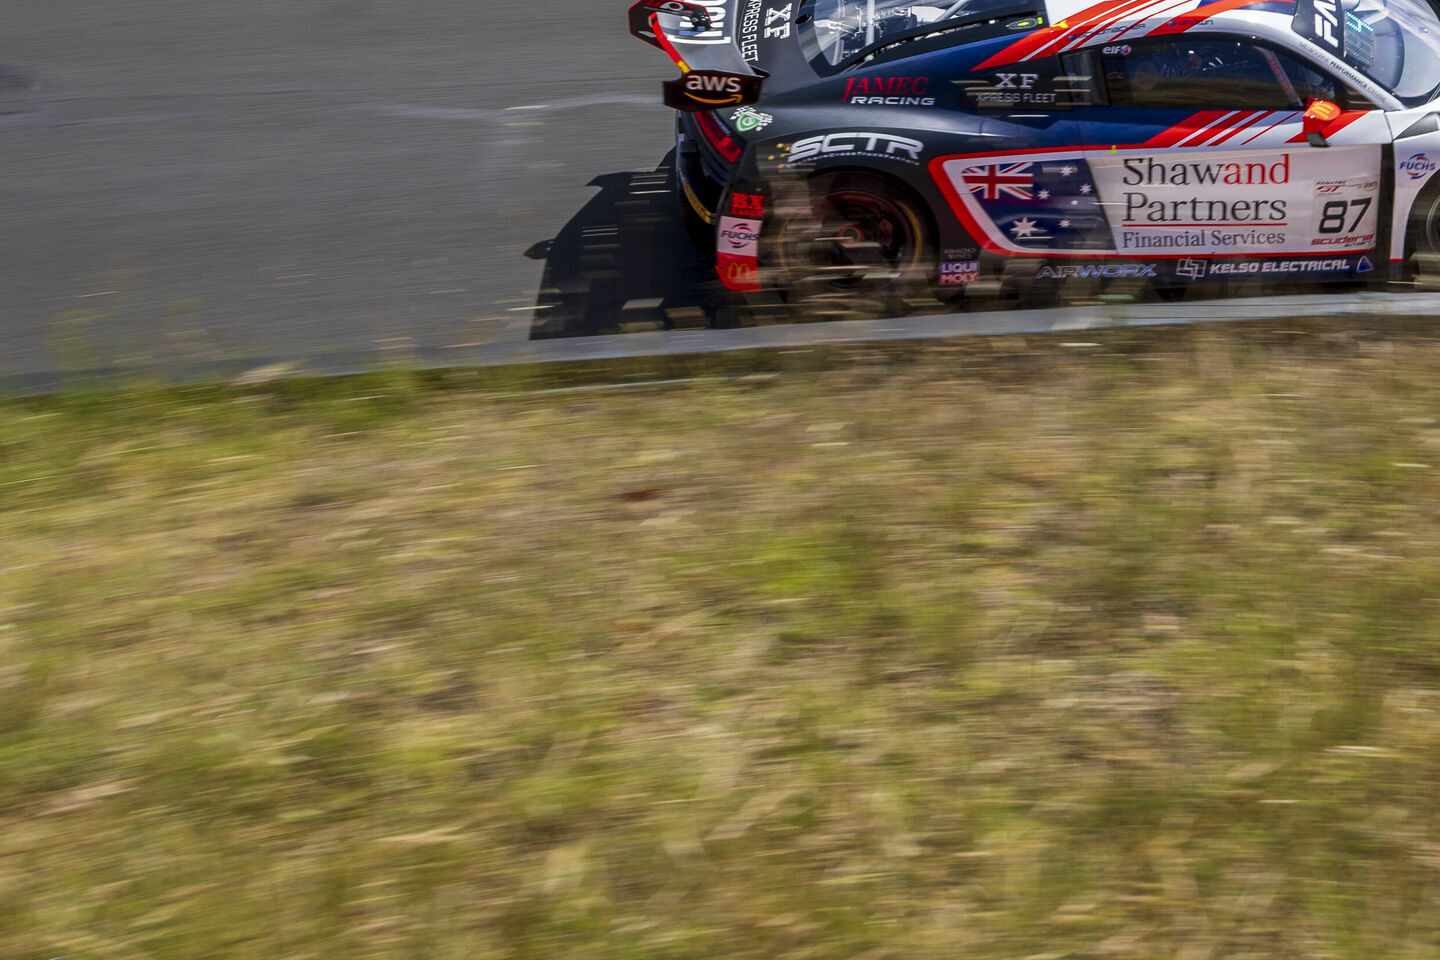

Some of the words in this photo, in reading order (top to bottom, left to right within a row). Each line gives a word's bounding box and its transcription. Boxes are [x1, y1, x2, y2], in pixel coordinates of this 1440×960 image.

[741, 34, 759, 62] FLEET
[1102, 46, 1121, 55] elf
[686, 75, 741, 92] aws
[995, 73, 1038, 89] XF
[840, 77, 929, 102] JAMEC
[976, 92, 1021, 103] XPRESS
[1022, 93, 1057, 103] FLEET
[850, 96, 935, 105] RACING
[787, 132, 924, 162] SCTR
[1122, 153, 1289, 186] Shawand
[1400, 161, 1437, 171] FUCHS
[1122, 192, 1287, 223] Partners
[1318, 197, 1372, 234] 87
[721, 230, 759, 241] FUCHS
[1122, 230, 1205, 249] Financial
[1210, 229, 1285, 245] Services
[941, 263, 978, 273] LIQUI
[1210, 262, 1259, 274] KELSO
[1261, 259, 1350, 272] ELECTRICAL
[941, 273, 978, 284] MOLY
